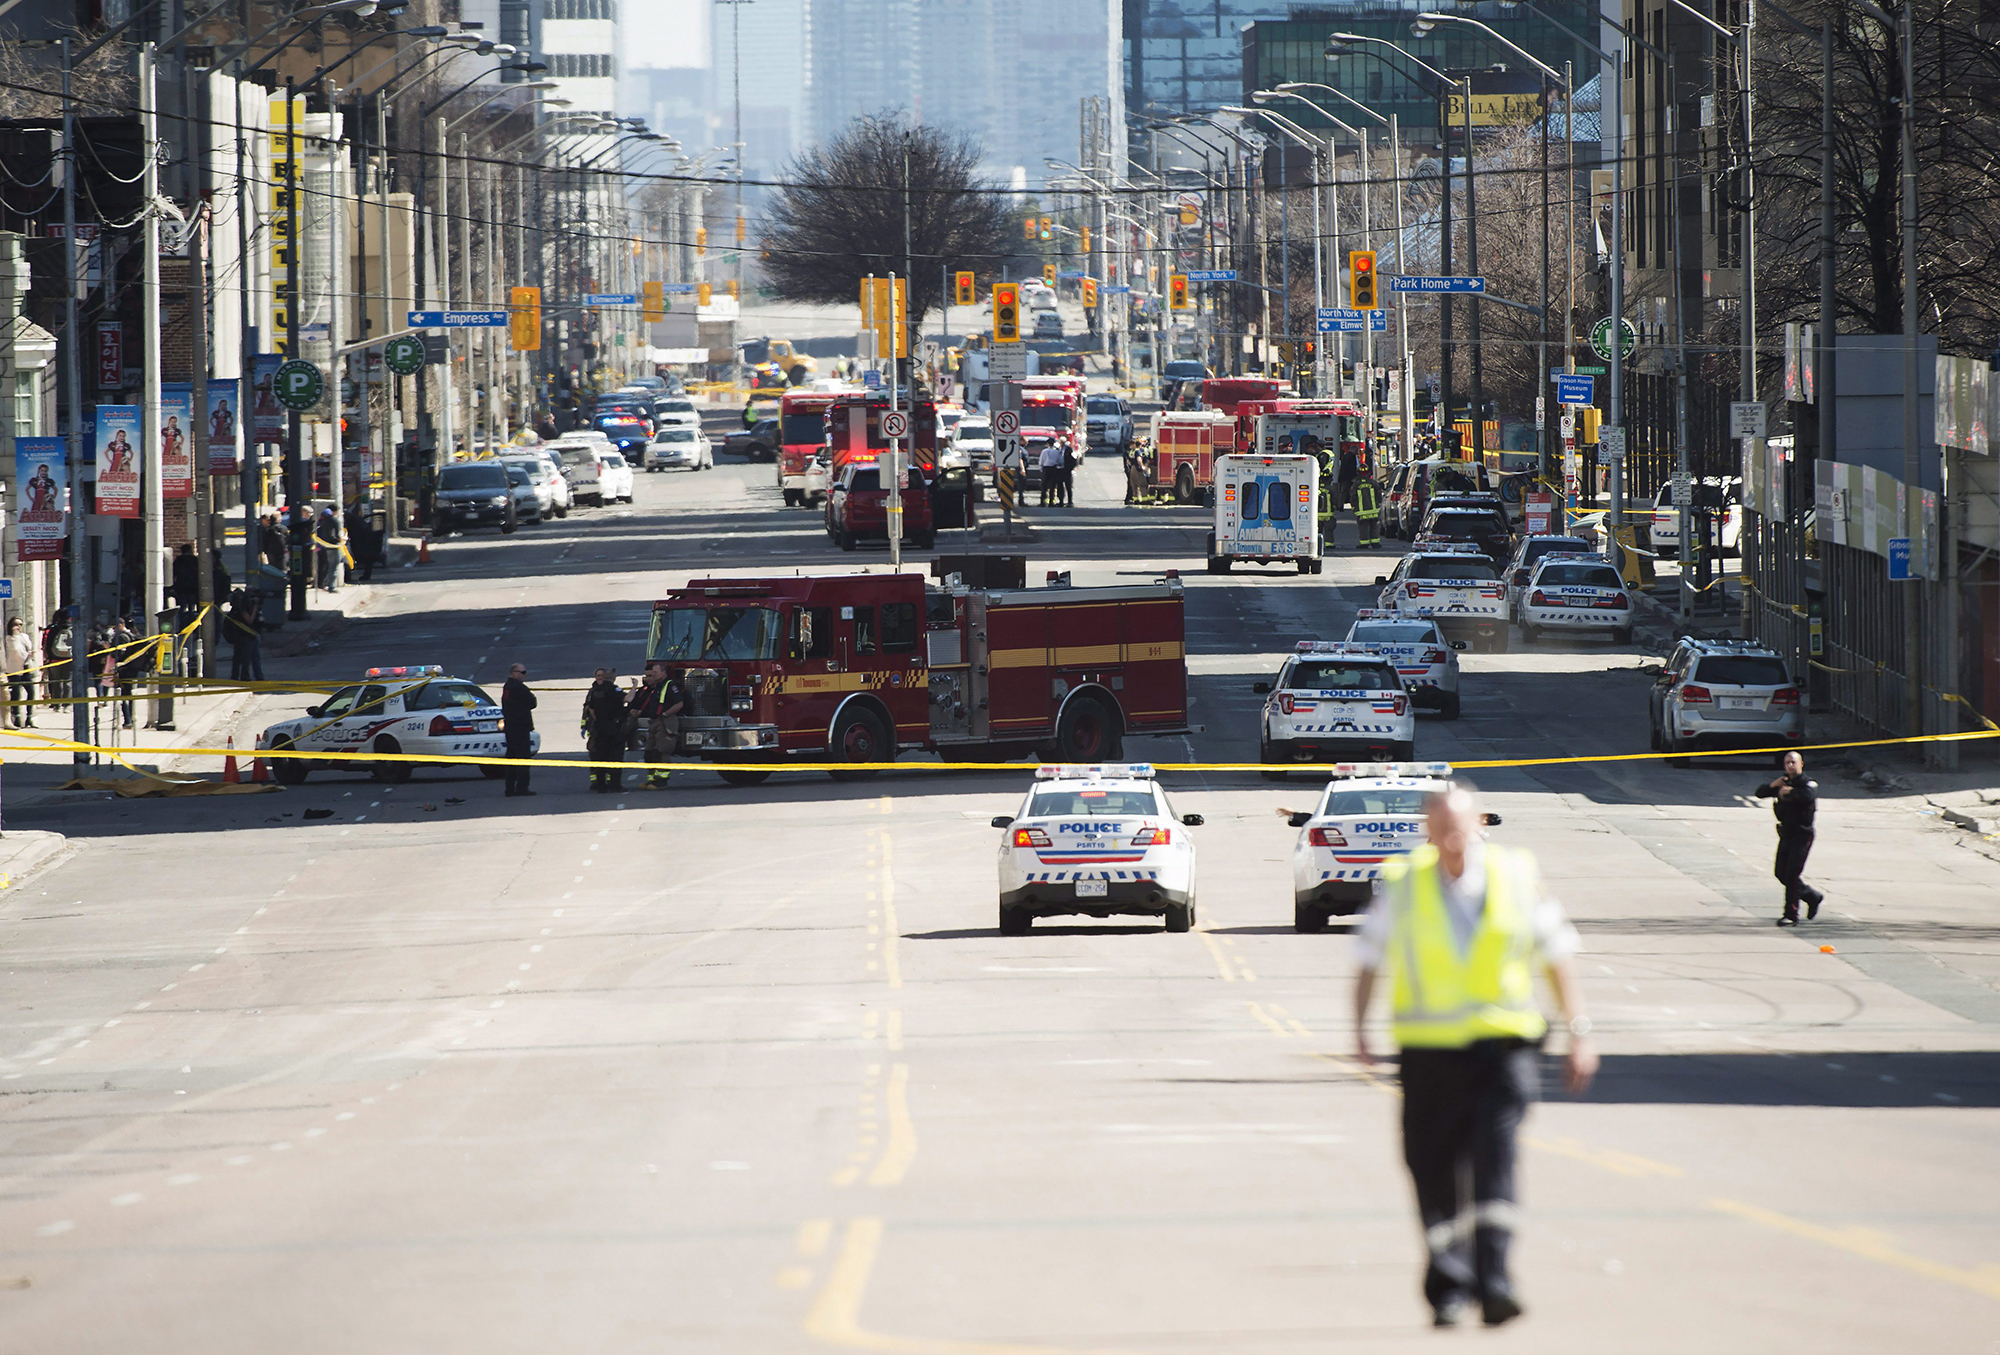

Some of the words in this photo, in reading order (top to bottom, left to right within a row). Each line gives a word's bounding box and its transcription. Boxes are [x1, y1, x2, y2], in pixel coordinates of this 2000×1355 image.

[1212, 271, 1228, 280] York
[1393, 278, 1418, 289] Park
[1421, 278, 1451, 289] Home
[443, 312, 491, 326] Empress
[1320, 309, 1342, 318] North
[1342, 309, 1359, 318] York
[397, 345, 413, 361] P
[1594, 342, 1633, 358] PARNG
[276, 361, 321, 381] MUNICIPAL
[289, 373, 310, 393] P
[1563, 384, 1589, 392] Museum
[276, 389, 321, 409] PARKING
[1271, 542, 1294, 554] EMS
[1561, 587, 1598, 595] POLICE
[1381, 647, 1415, 655] OLICE
[1320, 690, 1367, 698] POLICE
[467, 709, 502, 717] POLIC
[407, 722, 425, 731] 3241
[311, 728, 369, 742] POLICE
[1059, 822, 1122, 833] POLICE
[1355, 822, 1419, 833] POLICE
